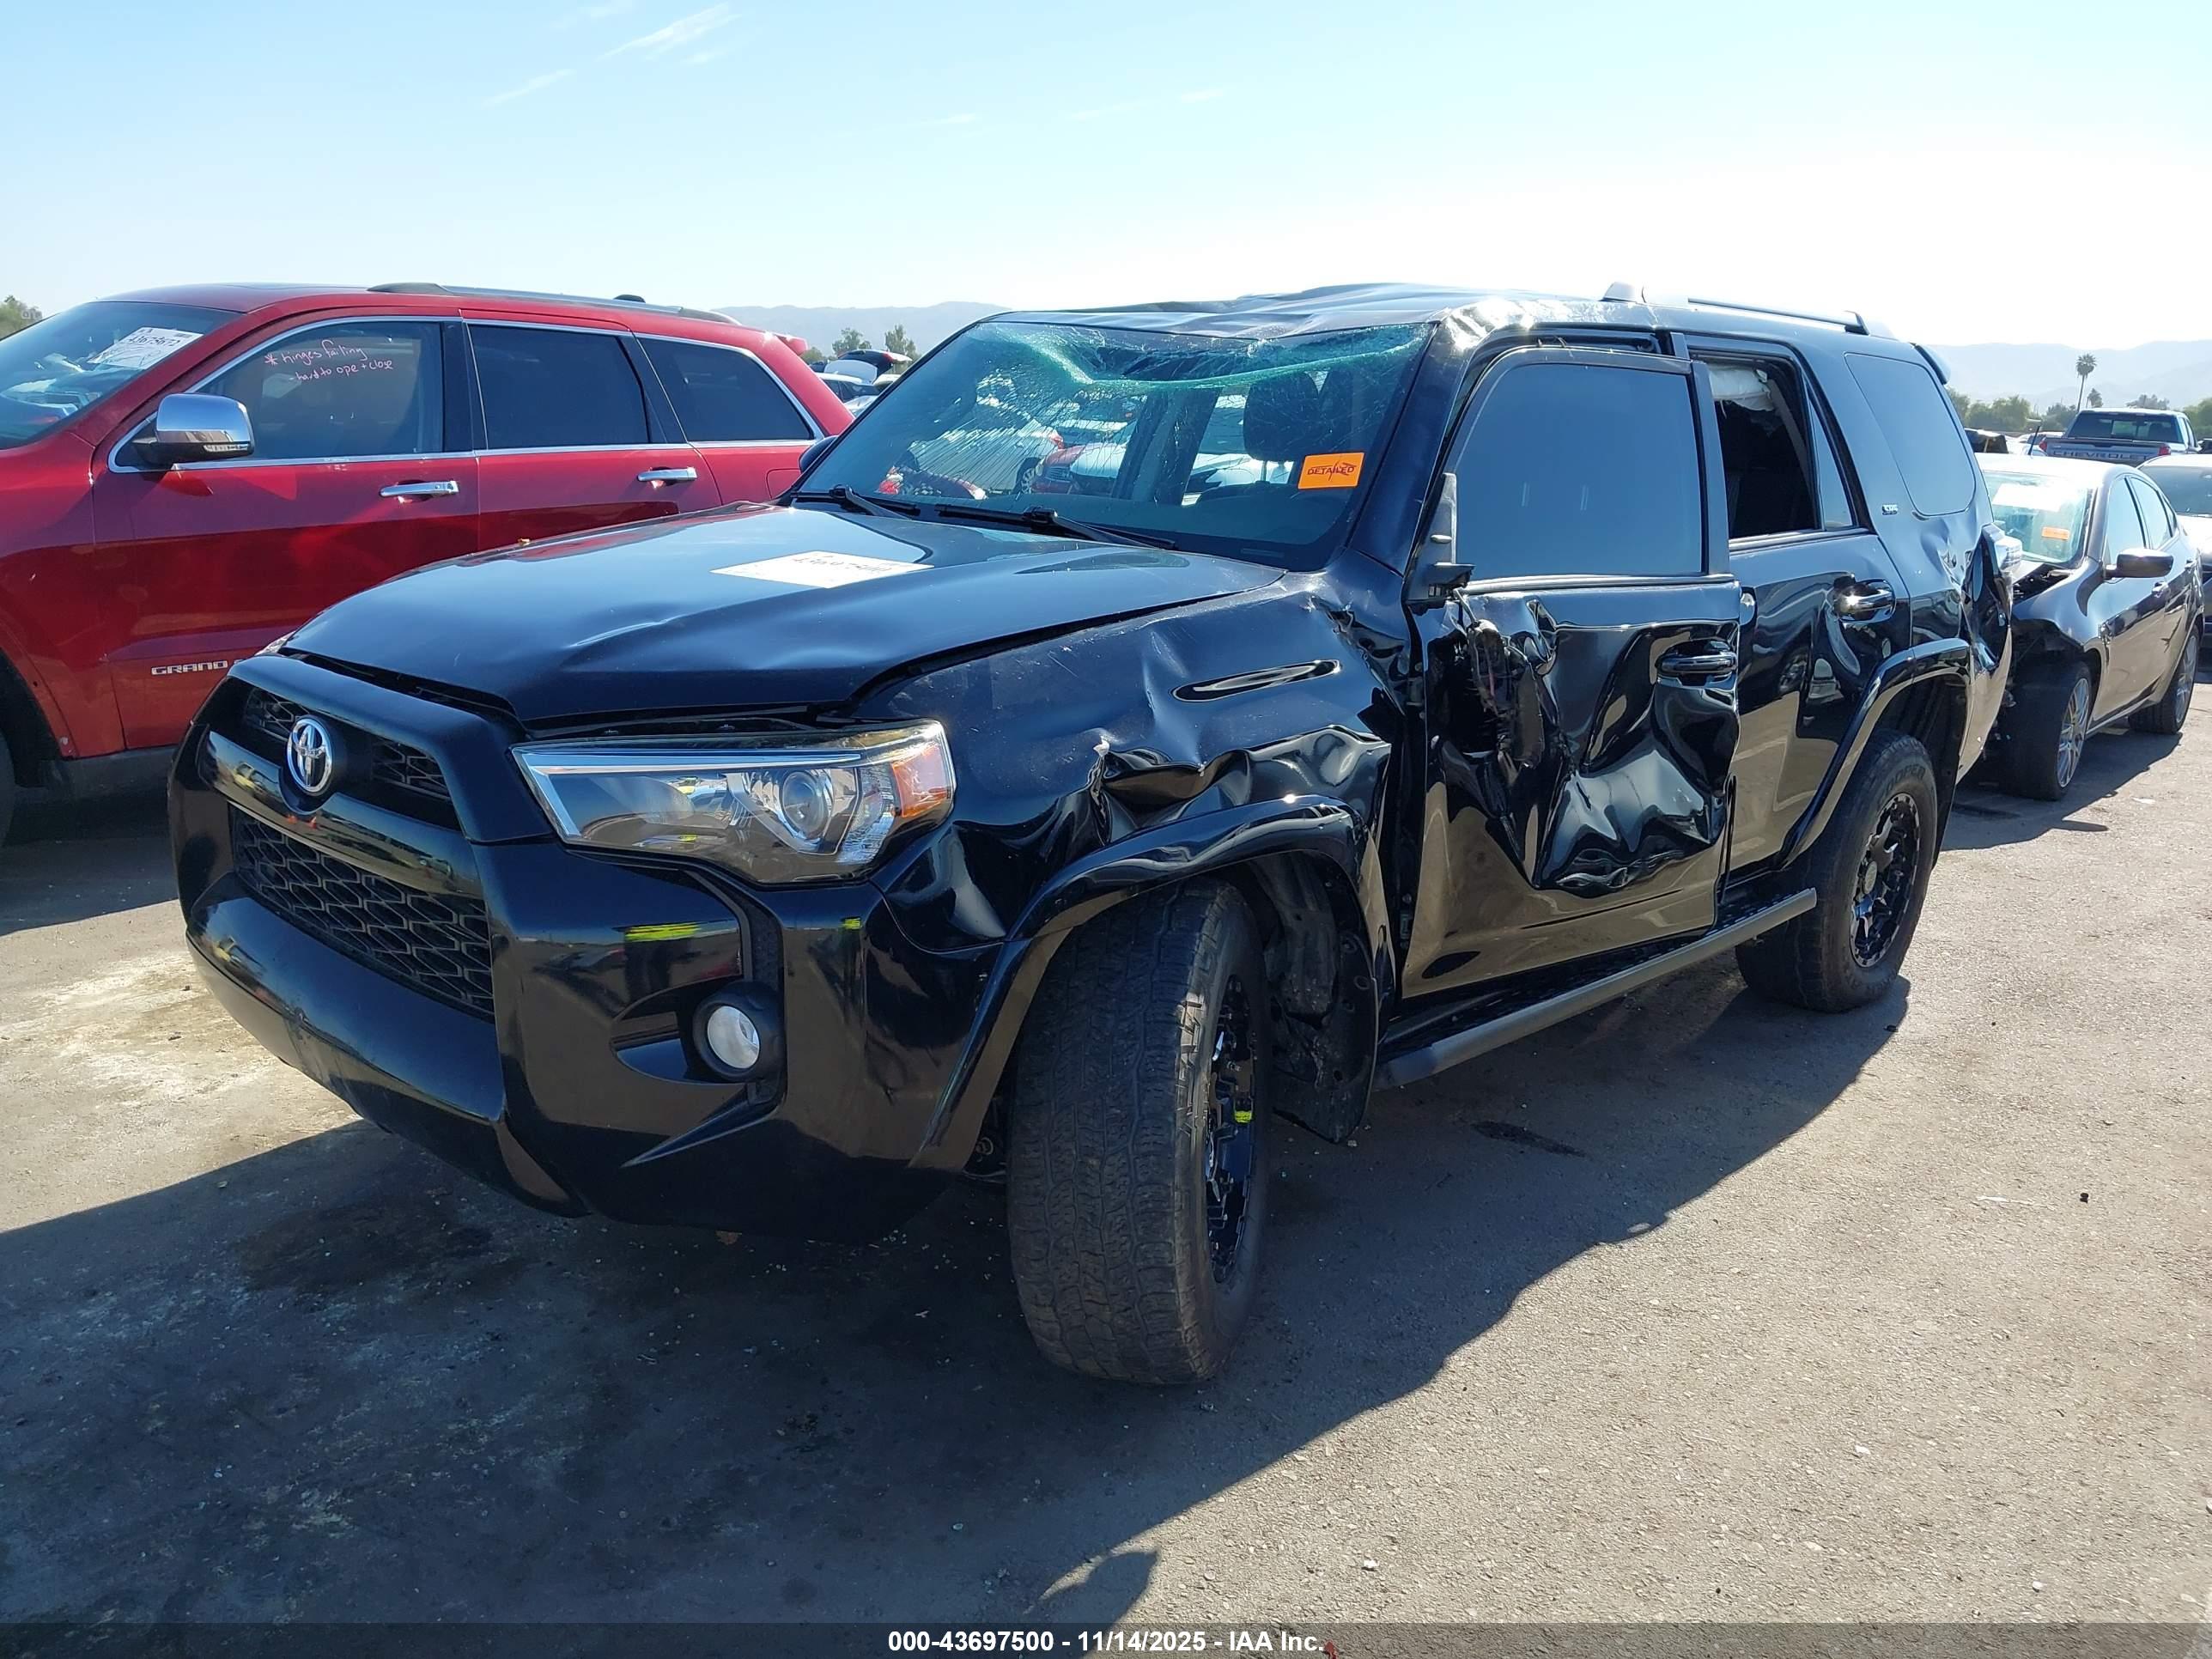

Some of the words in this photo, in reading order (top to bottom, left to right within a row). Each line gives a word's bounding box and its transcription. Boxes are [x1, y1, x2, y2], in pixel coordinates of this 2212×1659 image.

[282, 351, 322, 366] hinges
[321, 339, 368, 362] failing
[295, 368, 319, 380] hard
[319, 367, 332, 376] to
[2052, 450, 2148, 460] CHEVROLET
[1307, 465, 1355, 477] DETAILED
[151, 659, 228, 676] GRAND
